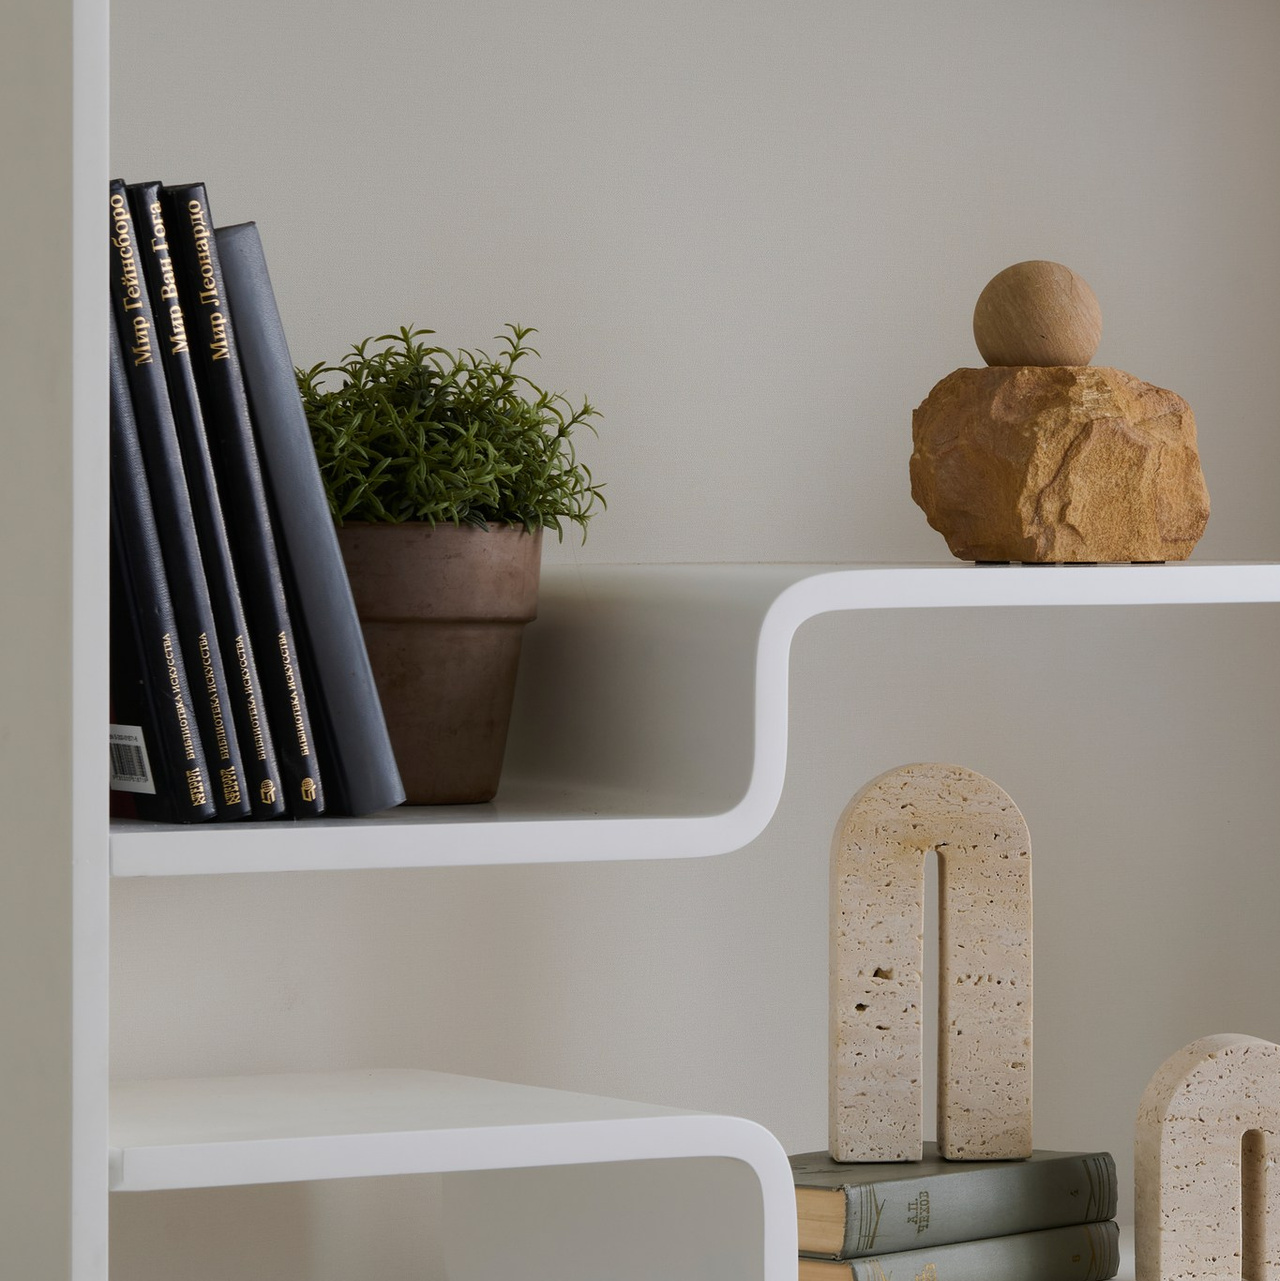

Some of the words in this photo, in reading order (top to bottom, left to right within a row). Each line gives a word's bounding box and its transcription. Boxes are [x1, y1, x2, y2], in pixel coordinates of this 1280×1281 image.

[110, 194, 144, 312] Гейнсборо
[149, 200, 169, 252] Гога
[188, 199, 221, 306] Леонардо
[161, 257, 178, 301] Ван
[133, 316, 154, 366] Мир
[169, 305, 189, 355] Мир
[210, 312, 231, 361] Мир
[162, 633, 181, 694] ИСКУССТВА
[198, 632, 217, 693] ИСКУССТВА
[235, 634, 254, 694] ИСКУССТВА
[278, 630, 297, 691] ИСКУССТВА
[173, 694, 196, 761] БИБЛИОТЕКА
[208, 693, 230, 760] БИБЛИОТЕКА
[245, 695, 267, 761] БИБЛИОТЕКА
[290, 690, 310, 757] БИБЛИОТЕКА
[907, 1198, 919, 1225] А.П.
[916, 1190, 930, 1234] ЧЕХОВ
